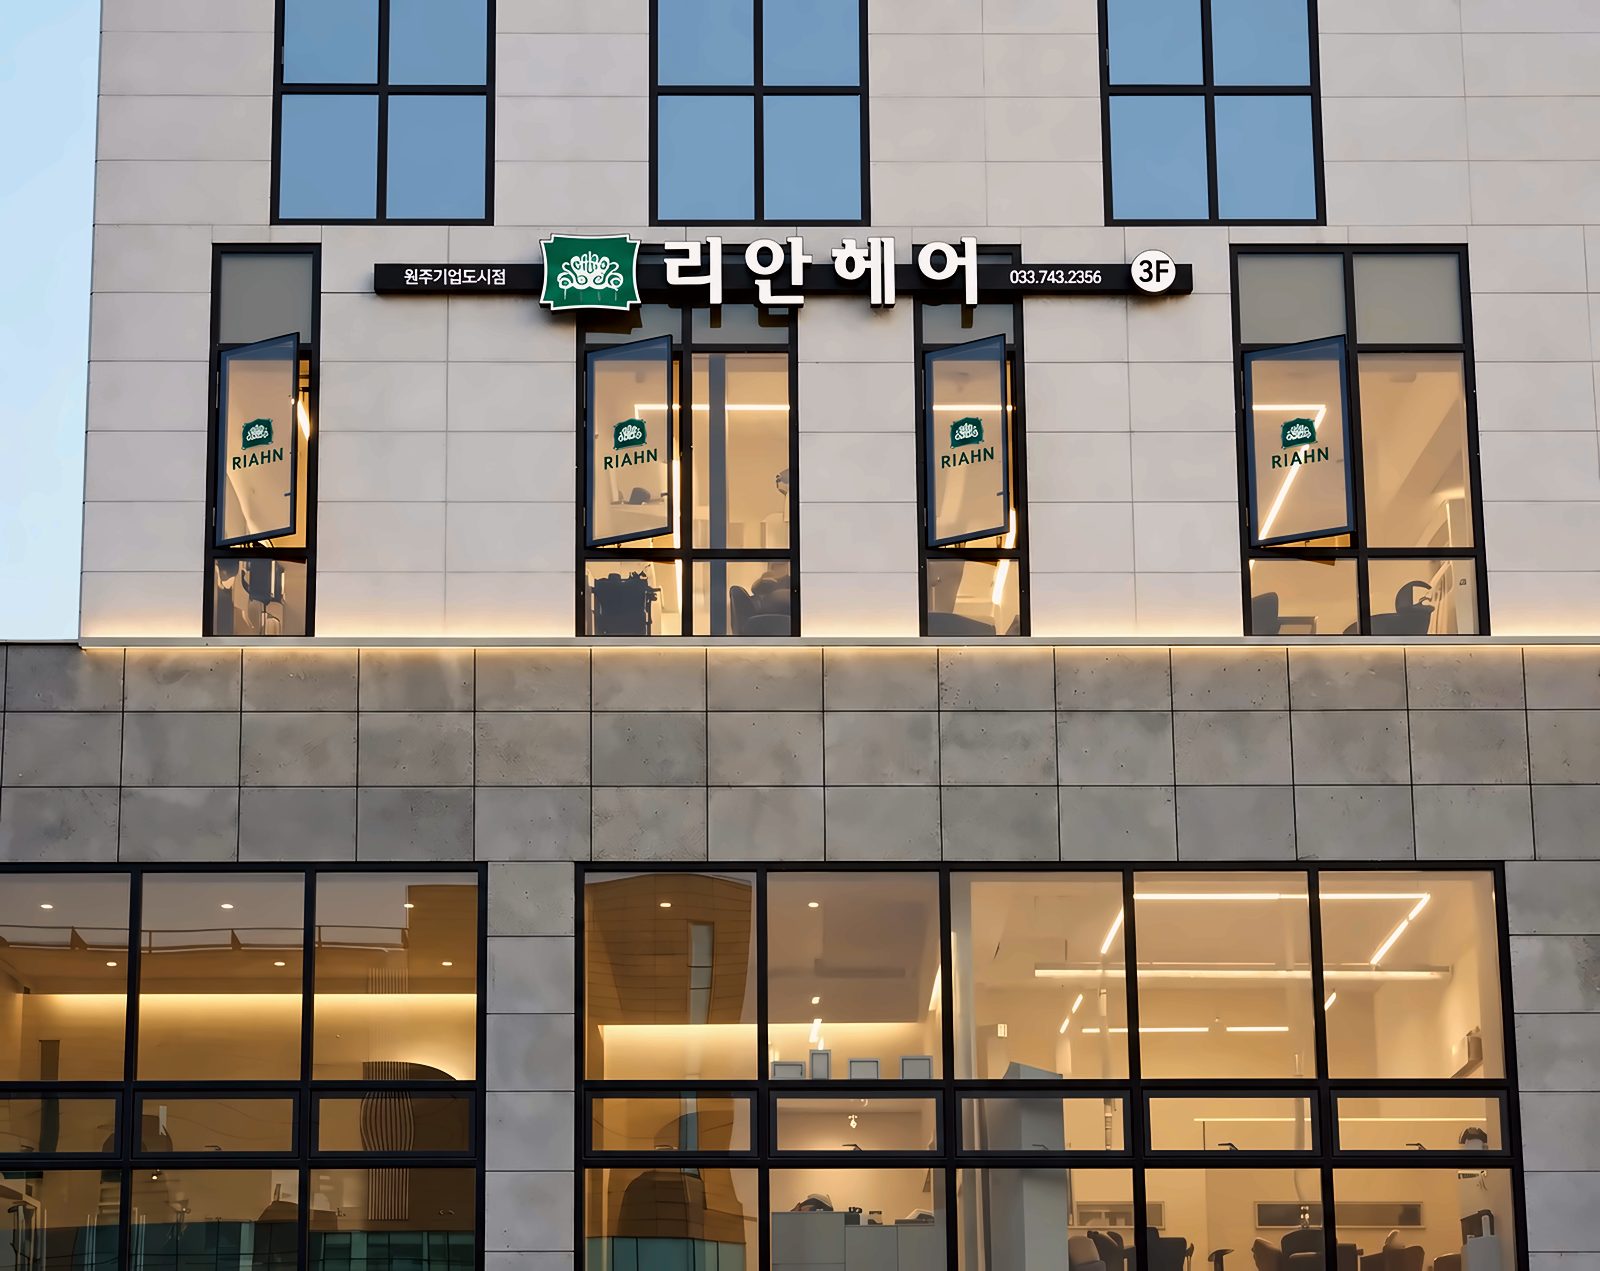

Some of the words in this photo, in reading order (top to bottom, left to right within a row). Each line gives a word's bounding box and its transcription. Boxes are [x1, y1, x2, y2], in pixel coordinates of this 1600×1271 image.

[403, 268, 506, 286] 원주기업도시점
[664, 237, 978, 305] 리안헤어
[1009, 269, 1102, 284] 033.743.2356
[1139, 259, 1169, 283] 3F
[232, 447, 284, 471] RIAHN
[603, 448, 658, 470] RIAHN
[941, 446, 994, 469] RIAHN
[1271, 446, 1329, 469] RIAHN
